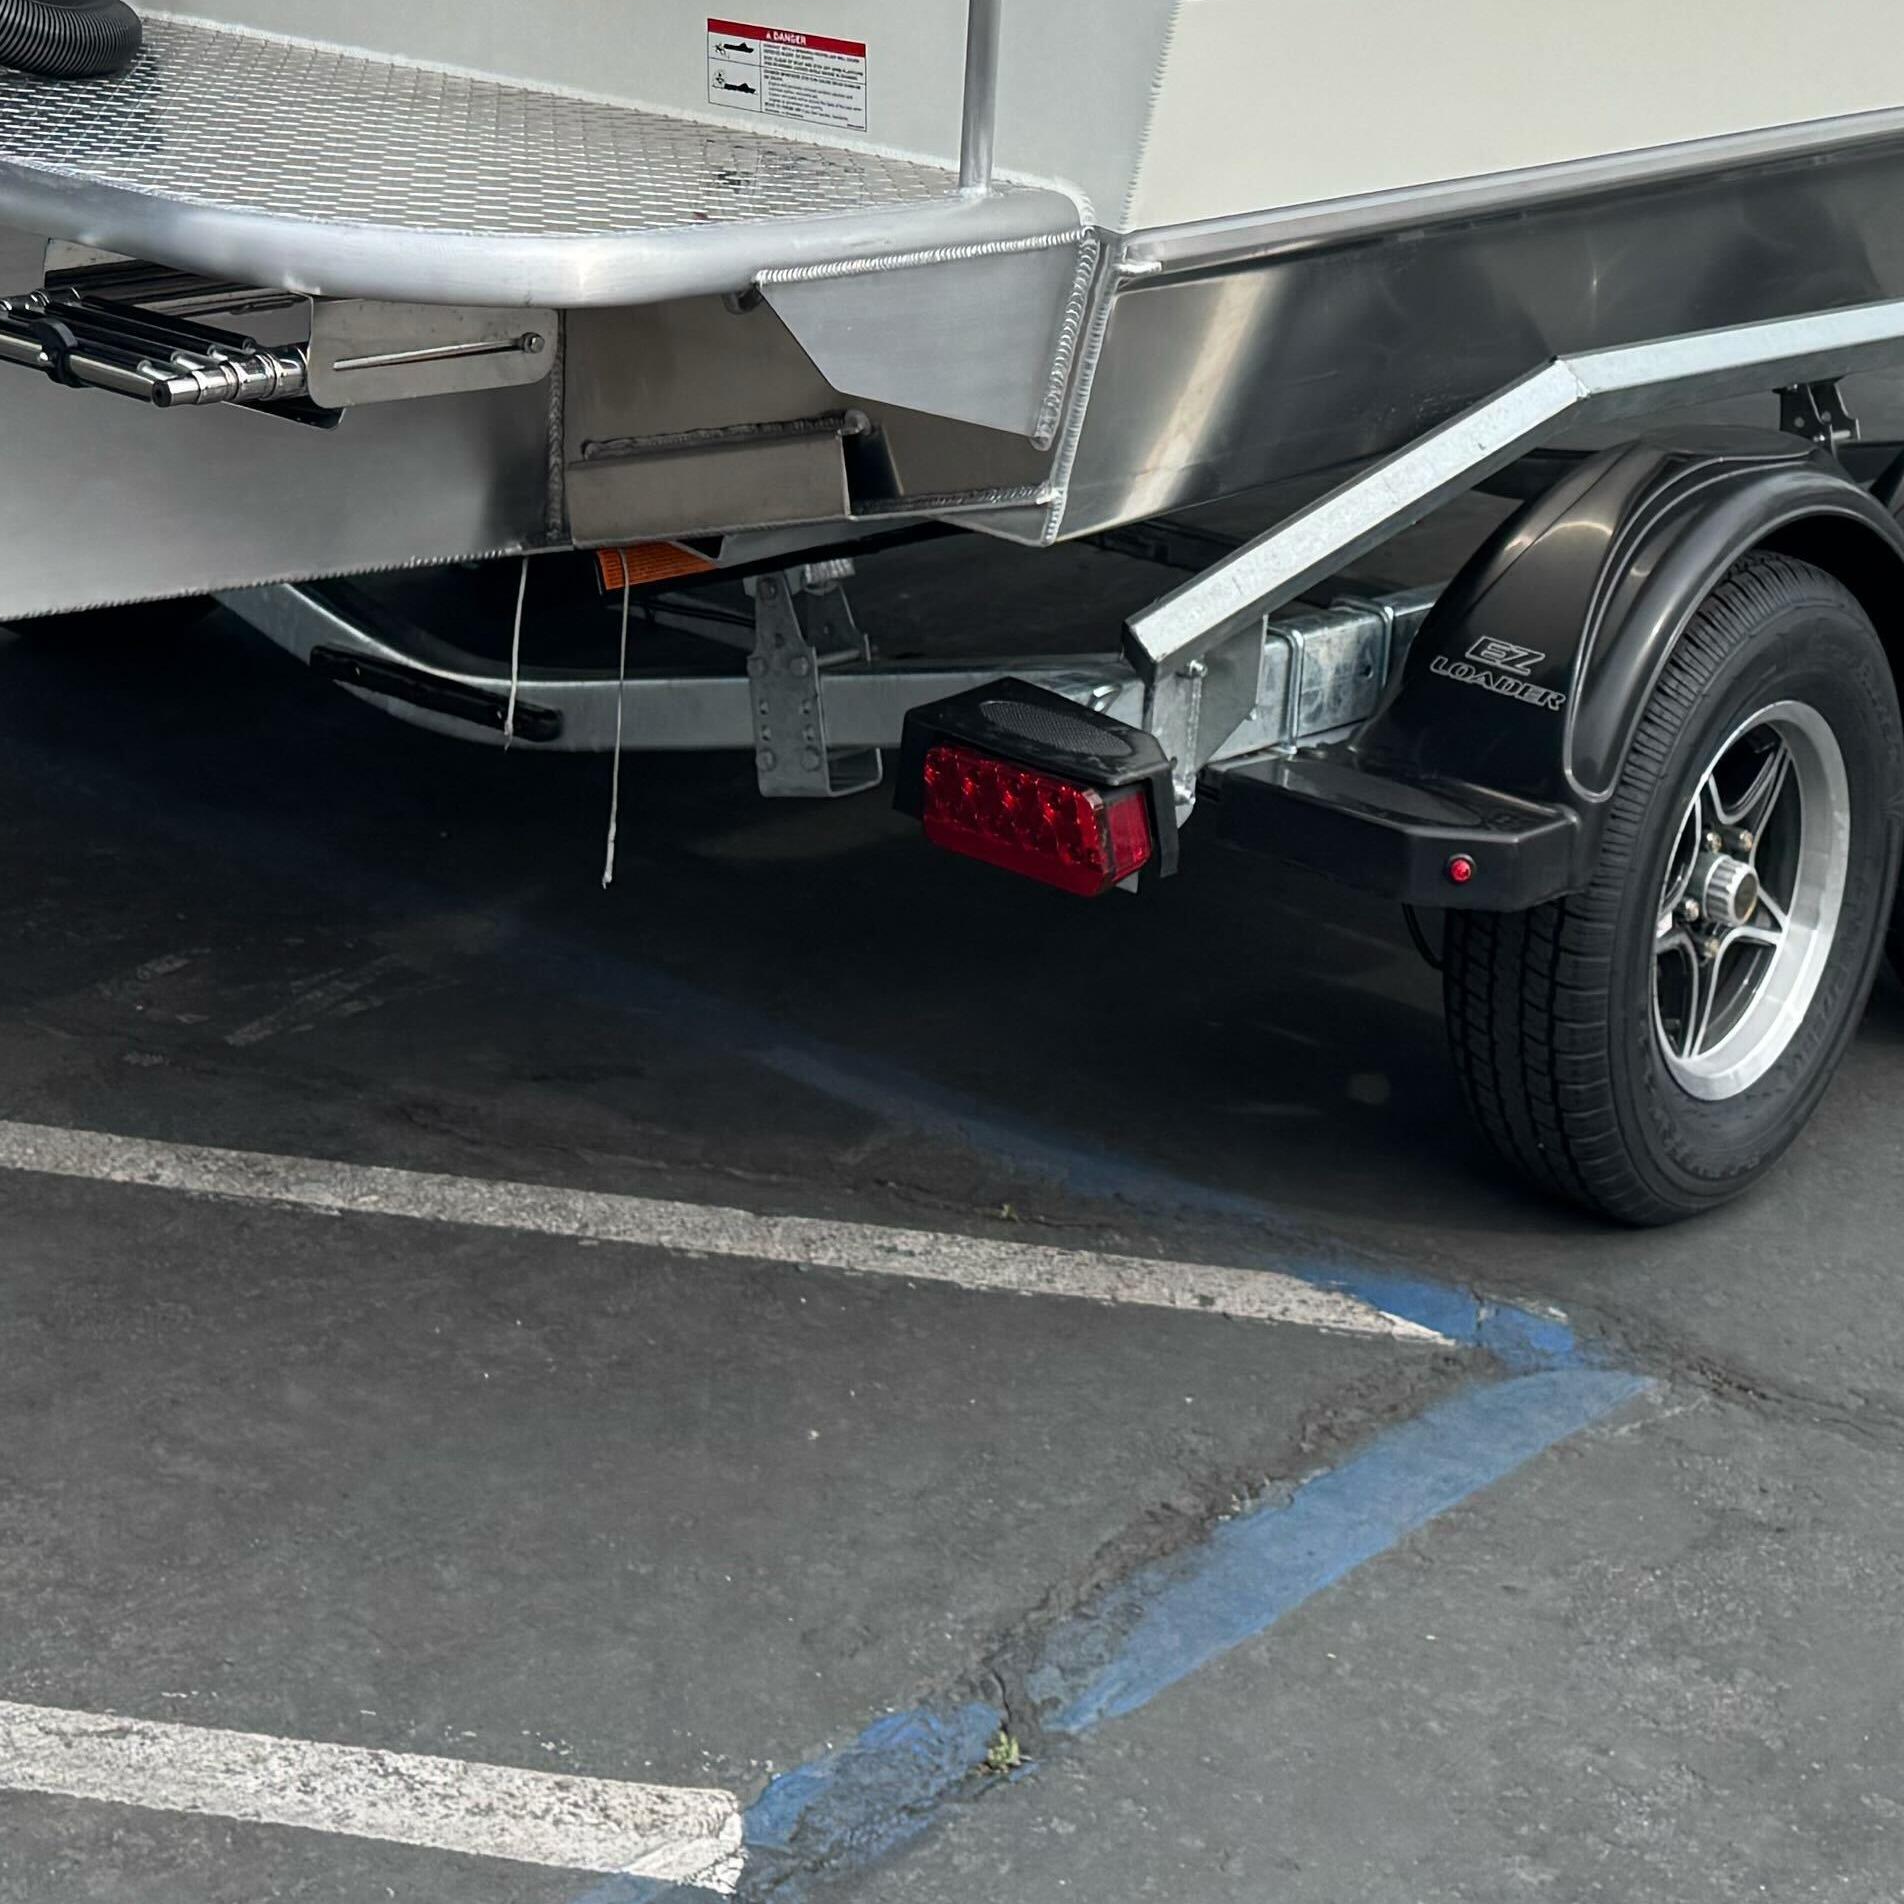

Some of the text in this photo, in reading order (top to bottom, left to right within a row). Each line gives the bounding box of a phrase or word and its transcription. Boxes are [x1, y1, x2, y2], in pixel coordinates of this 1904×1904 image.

[773, 30, 807, 46] DANGER
[1464, 635, 1546, 676] EZ
[1429, 655, 1567, 711] LOADER
